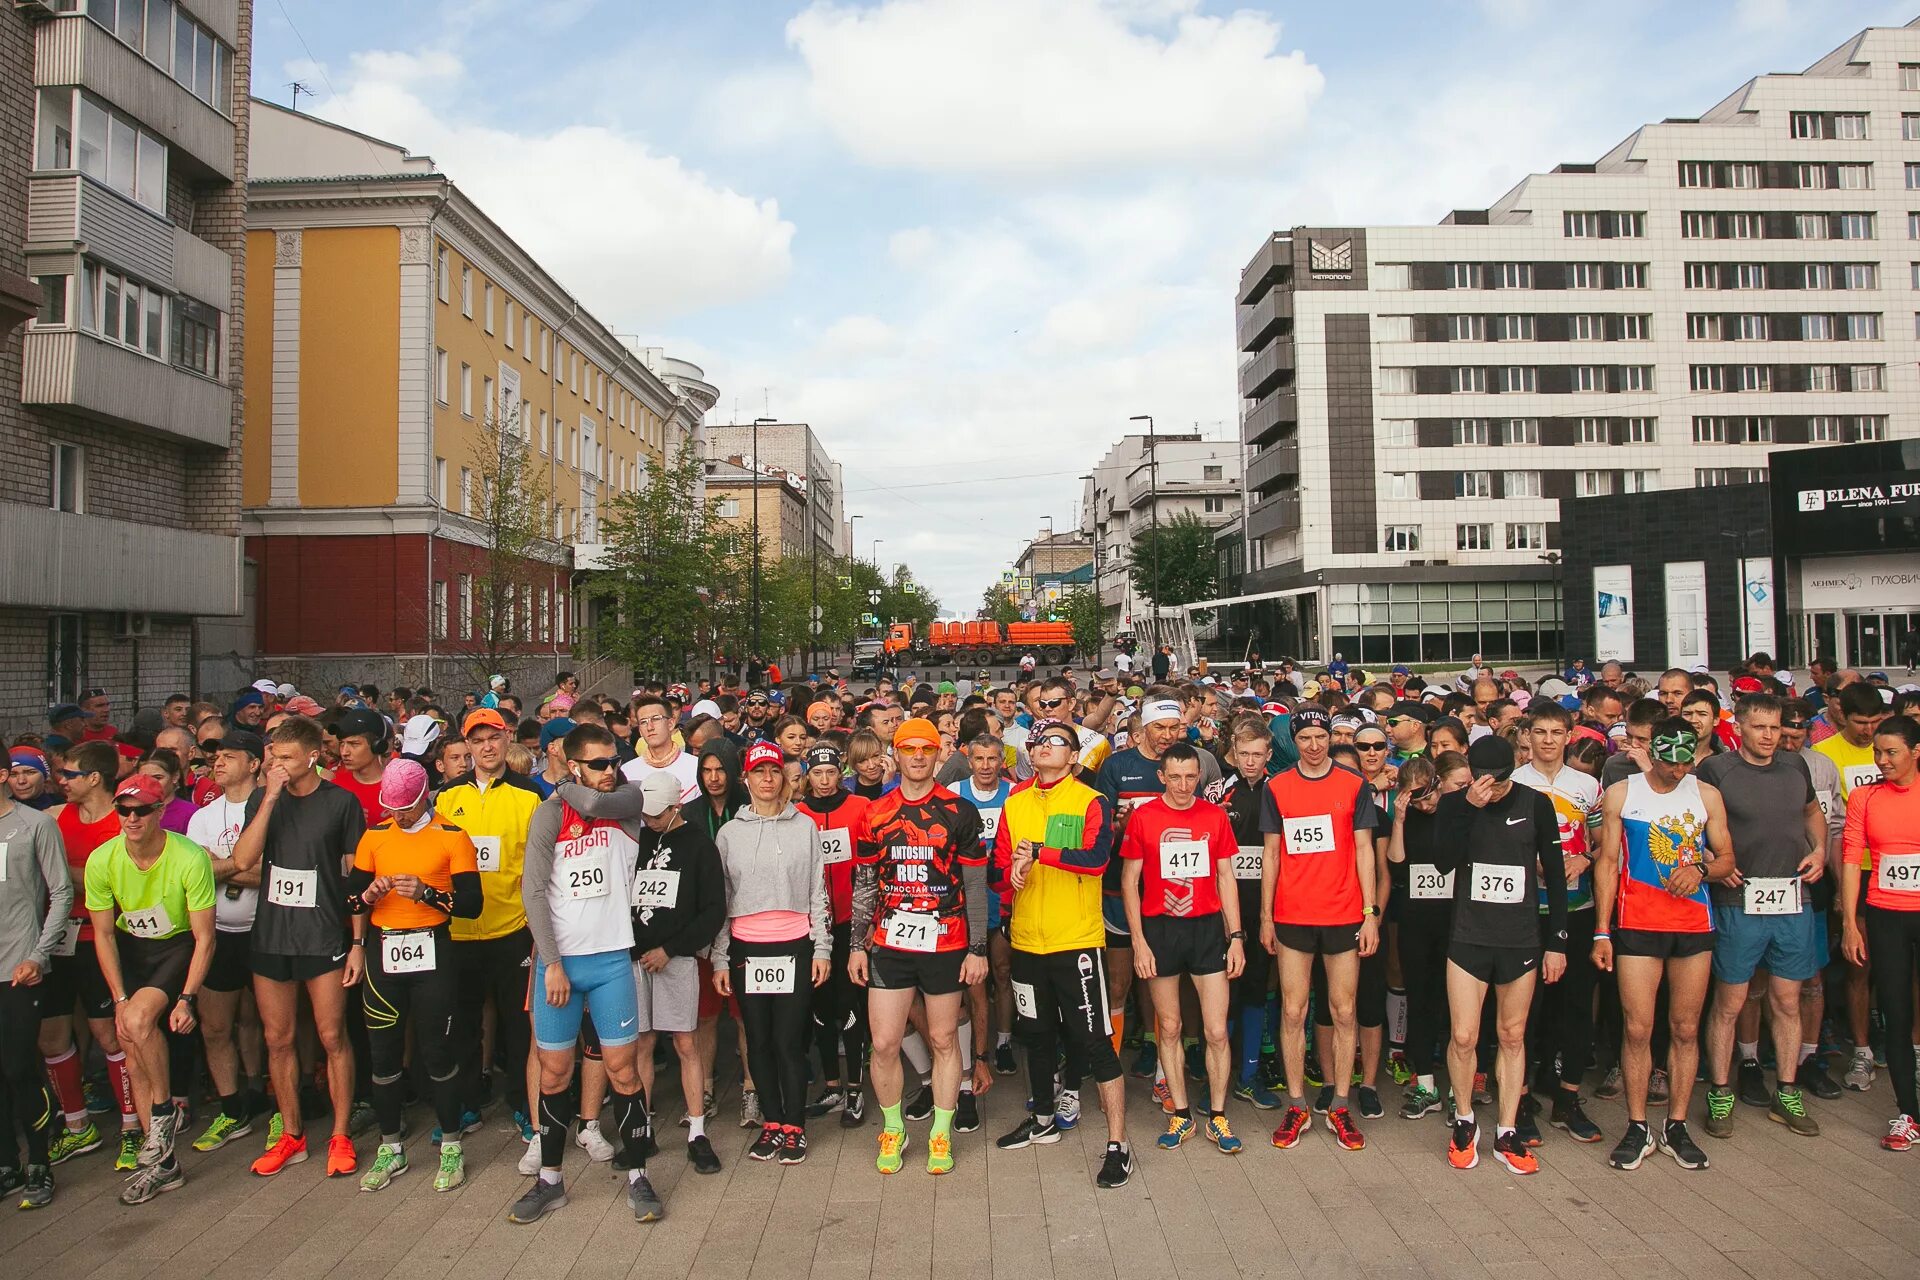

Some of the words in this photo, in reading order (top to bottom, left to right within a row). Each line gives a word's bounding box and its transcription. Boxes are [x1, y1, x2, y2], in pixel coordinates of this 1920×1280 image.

[1826, 486, 1884, 503] ELENA
[1858, 500, 1873, 508] since
[1874, 499, 1890, 507] 1991
[1293, 826, 1323, 843] 455
[891, 846, 934, 860] ANTOSHIN
[1169, 852, 1200, 867] 417
[1236, 856, 1262, 870] 229
[569, 867, 604, 888] 250
[896, 864, 929, 882] RUS
[1887, 865, 1920, 881] 497
[276, 879, 304, 897] 191
[638, 880, 668, 896] 242
[1417, 874, 1446, 889] 230
[1481, 875, 1514, 893] 376
[1755, 889, 1786, 904] 247
[127, 916, 158, 930] 441
[895, 922, 926, 940] 271
[391, 944, 425, 962] 064
[754, 968, 785, 983] 060
[1077, 953, 1095, 1033] Champion
